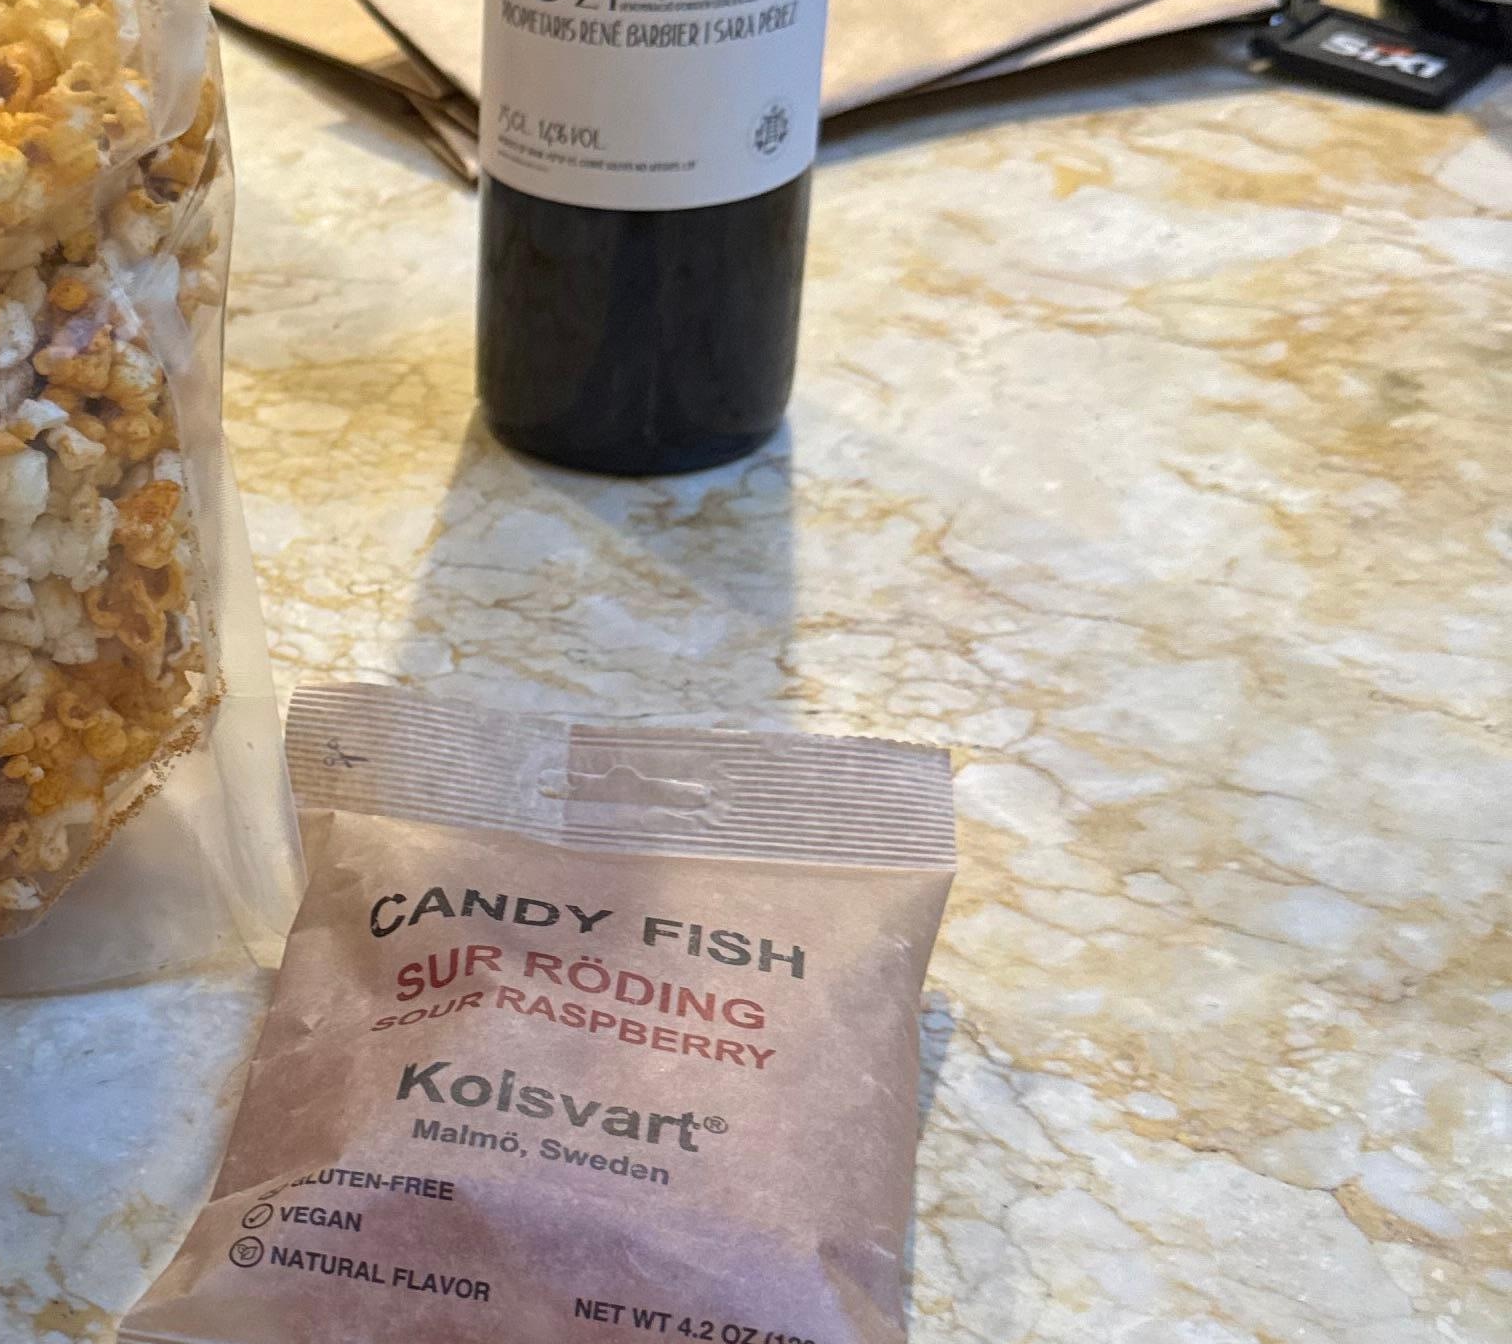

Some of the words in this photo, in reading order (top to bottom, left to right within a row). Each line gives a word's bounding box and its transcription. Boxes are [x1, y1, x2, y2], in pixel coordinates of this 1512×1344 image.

[579, 17, 623, 48] RENÉ
[625, 18, 697, 49] BARBIER
[714, 13, 755, 44] SARA
[369, 885, 614, 939] CANDY
[642, 915, 807, 979] FISH
[396, 943, 504, 1003] SUR
[523, 949, 768, 1031] RÖDING
[369, 990, 485, 1033] SOUR
[495, 984, 778, 1071] RASPBERRY
[411, 1117, 528, 1158] Malmö,
[539, 1137, 671, 1186] Sweden
[278, 1206, 363, 1233] VEGAN
[270, 1245, 386, 1285] NATURAL
[392, 1266, 491, 1303] FLAVOR
[574, 1297, 626, 1325] NET
[631, 1307, 672, 1333] WT
[677, 1317, 714, 1341] 4.2
